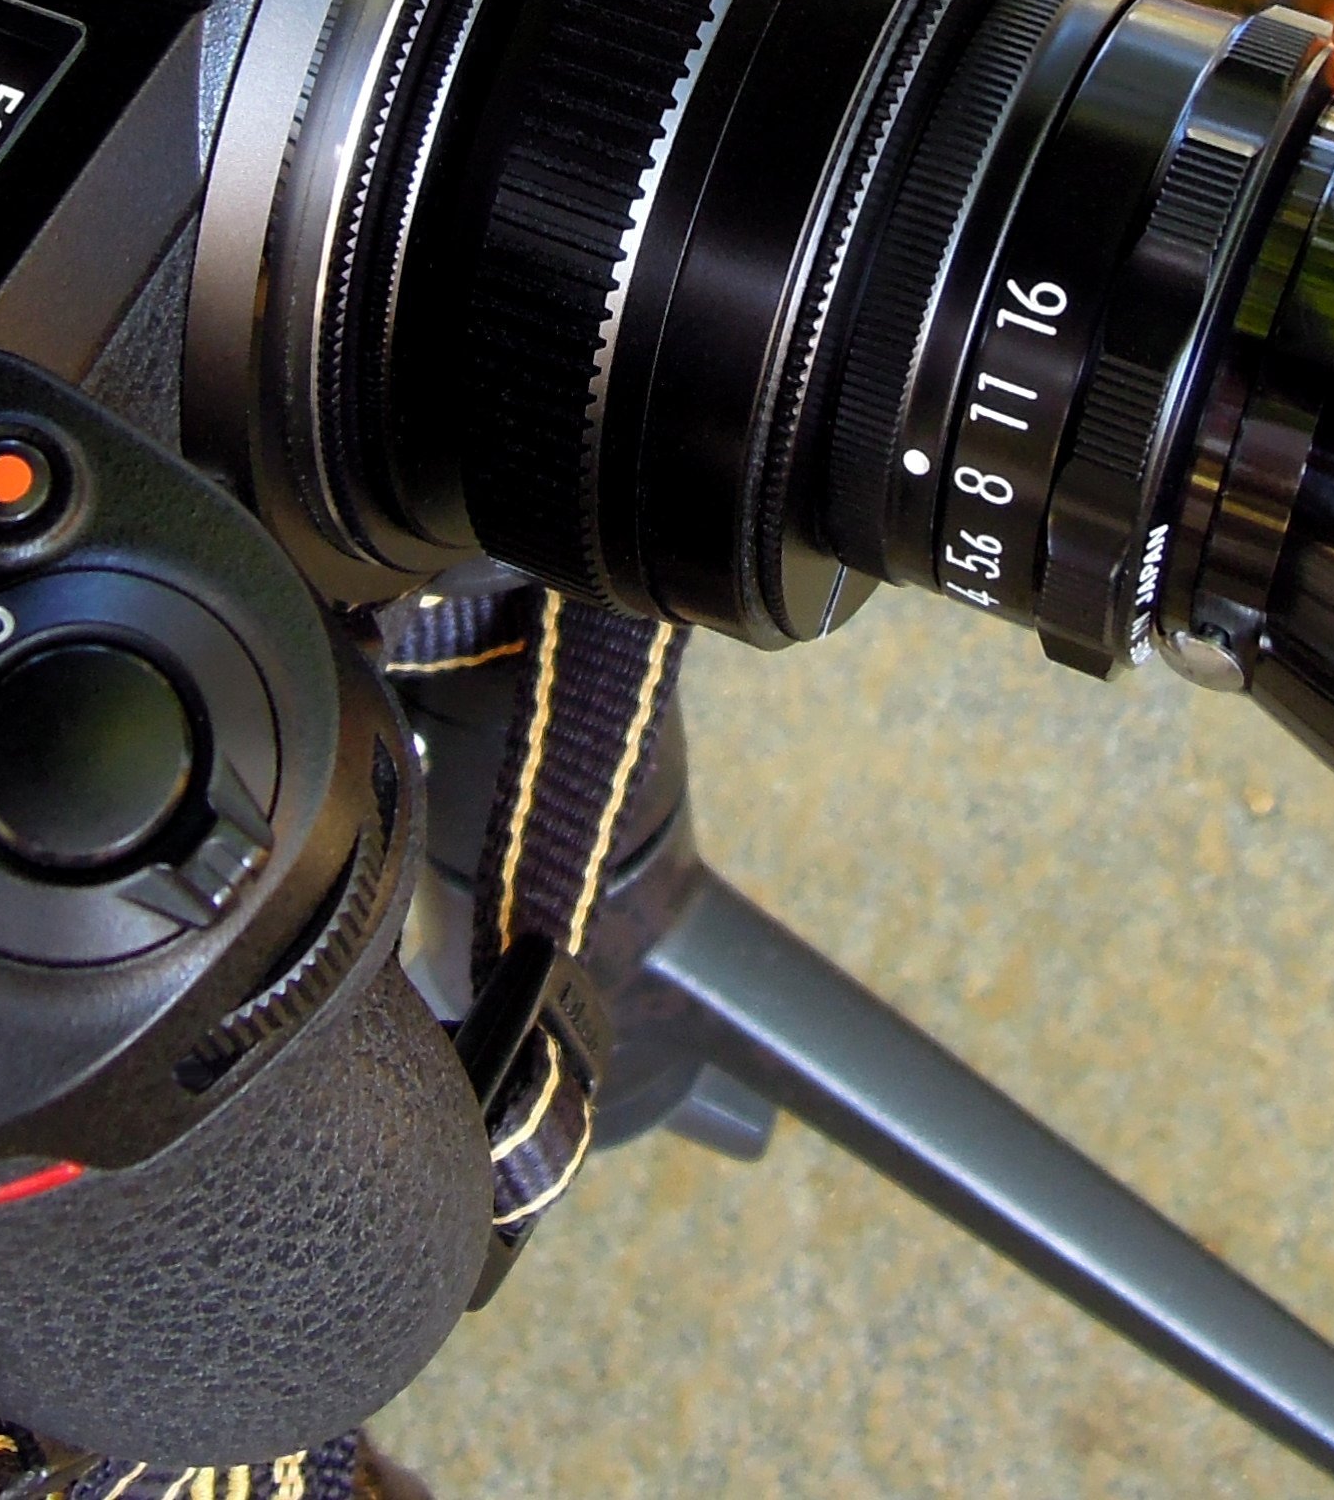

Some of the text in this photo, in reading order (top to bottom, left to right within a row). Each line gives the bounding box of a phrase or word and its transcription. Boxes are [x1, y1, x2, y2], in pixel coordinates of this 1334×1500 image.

[945, 278, 1067, 606] 4 5.6 8 11 16
[1134, 523, 1169, 606] JAPAN
